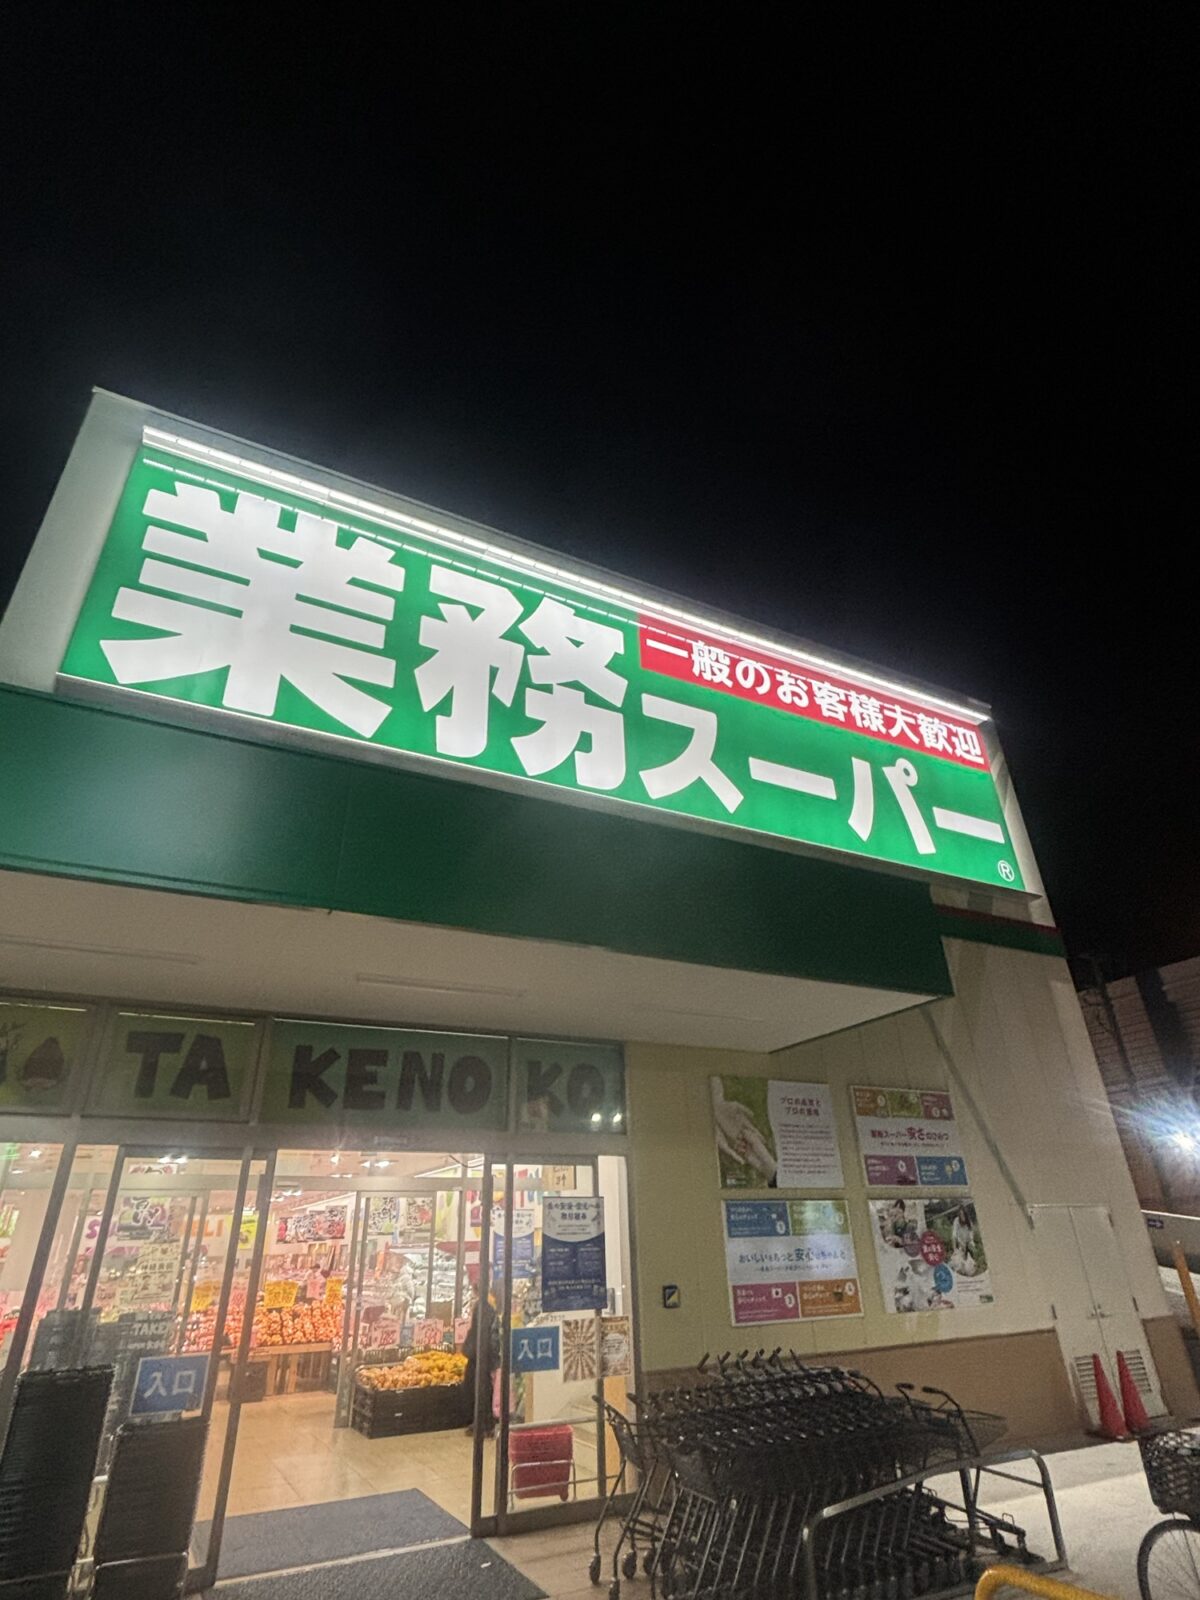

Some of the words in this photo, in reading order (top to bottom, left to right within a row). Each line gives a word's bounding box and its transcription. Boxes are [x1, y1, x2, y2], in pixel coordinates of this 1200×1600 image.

[100, 482, 1004, 854] 業務スーパー
[646, 638, 985, 764] 一般のお客様大歓迎
[143, 1371, 196, 1399] 入口
[517, 1338, 553, 1360] 入口
